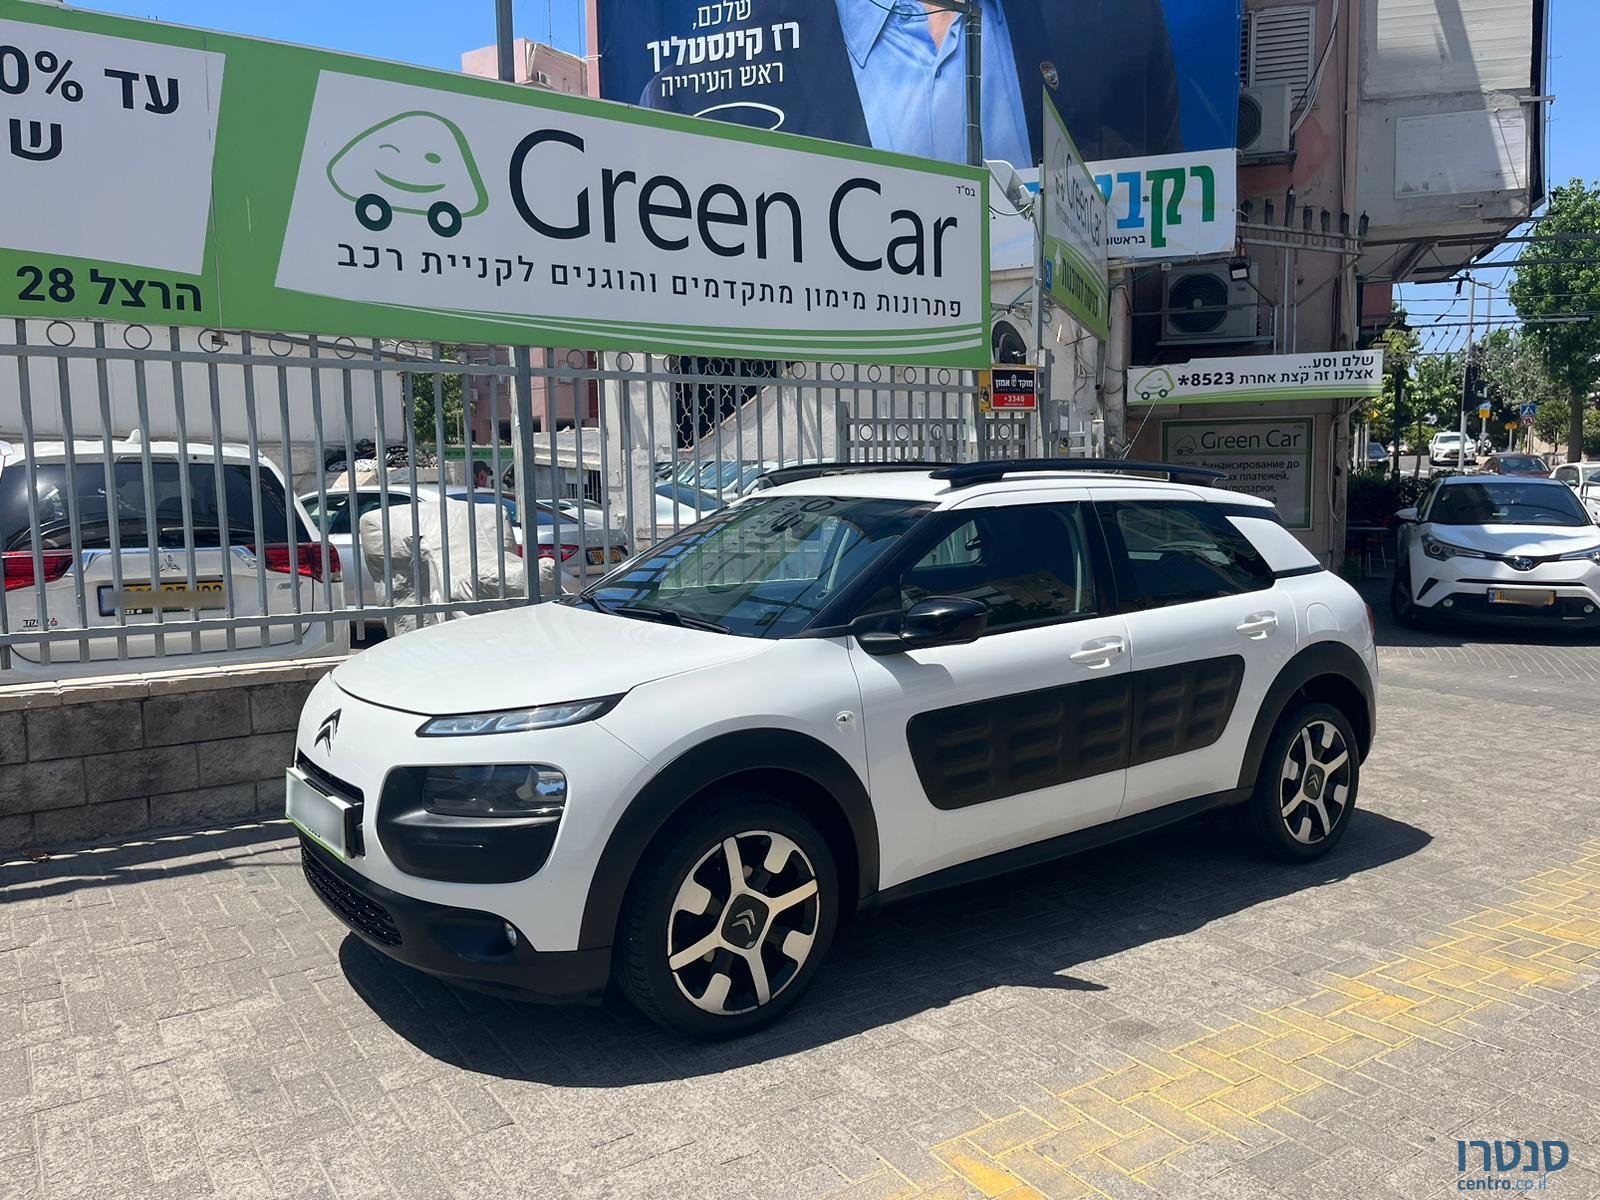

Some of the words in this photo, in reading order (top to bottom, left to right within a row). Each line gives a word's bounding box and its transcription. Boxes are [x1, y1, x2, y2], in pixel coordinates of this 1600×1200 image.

[692, 0, 751, 30] שלכם,
[646, 27, 763, 73] קינסטליך
[771, 21, 800, 51] רז
[661, 69, 733, 97] העירייה
[739, 62, 784, 87] ראש
[104, 68, 179, 115] עד
[508, 128, 804, 264] Green
[828, 177, 958, 279] Car
[337, 243, 403, 271] רכב
[421, 251, 535, 287] לקניית
[16, 265, 76, 303] 28
[89, 268, 202, 312] הרצל
[551, 263, 657, 293] והוגנים
[672, 274, 794, 307] מתקדמים
[804, 286, 867, 311] מימון
[876, 292, 962, 318] פתרונות
[1299, 357, 1337, 369] וסע...
[1334, 367, 1374, 380] אצלנו
[1342, 354, 1374, 367] שלם
[1239, 373, 1276, 385] אחרת
[1280, 372, 1310, 385] קצת
[1314, 370, 1330, 381] זה
[1200, 431, 1260, 449] Green
[1266, 429, 1301, 448] Car
